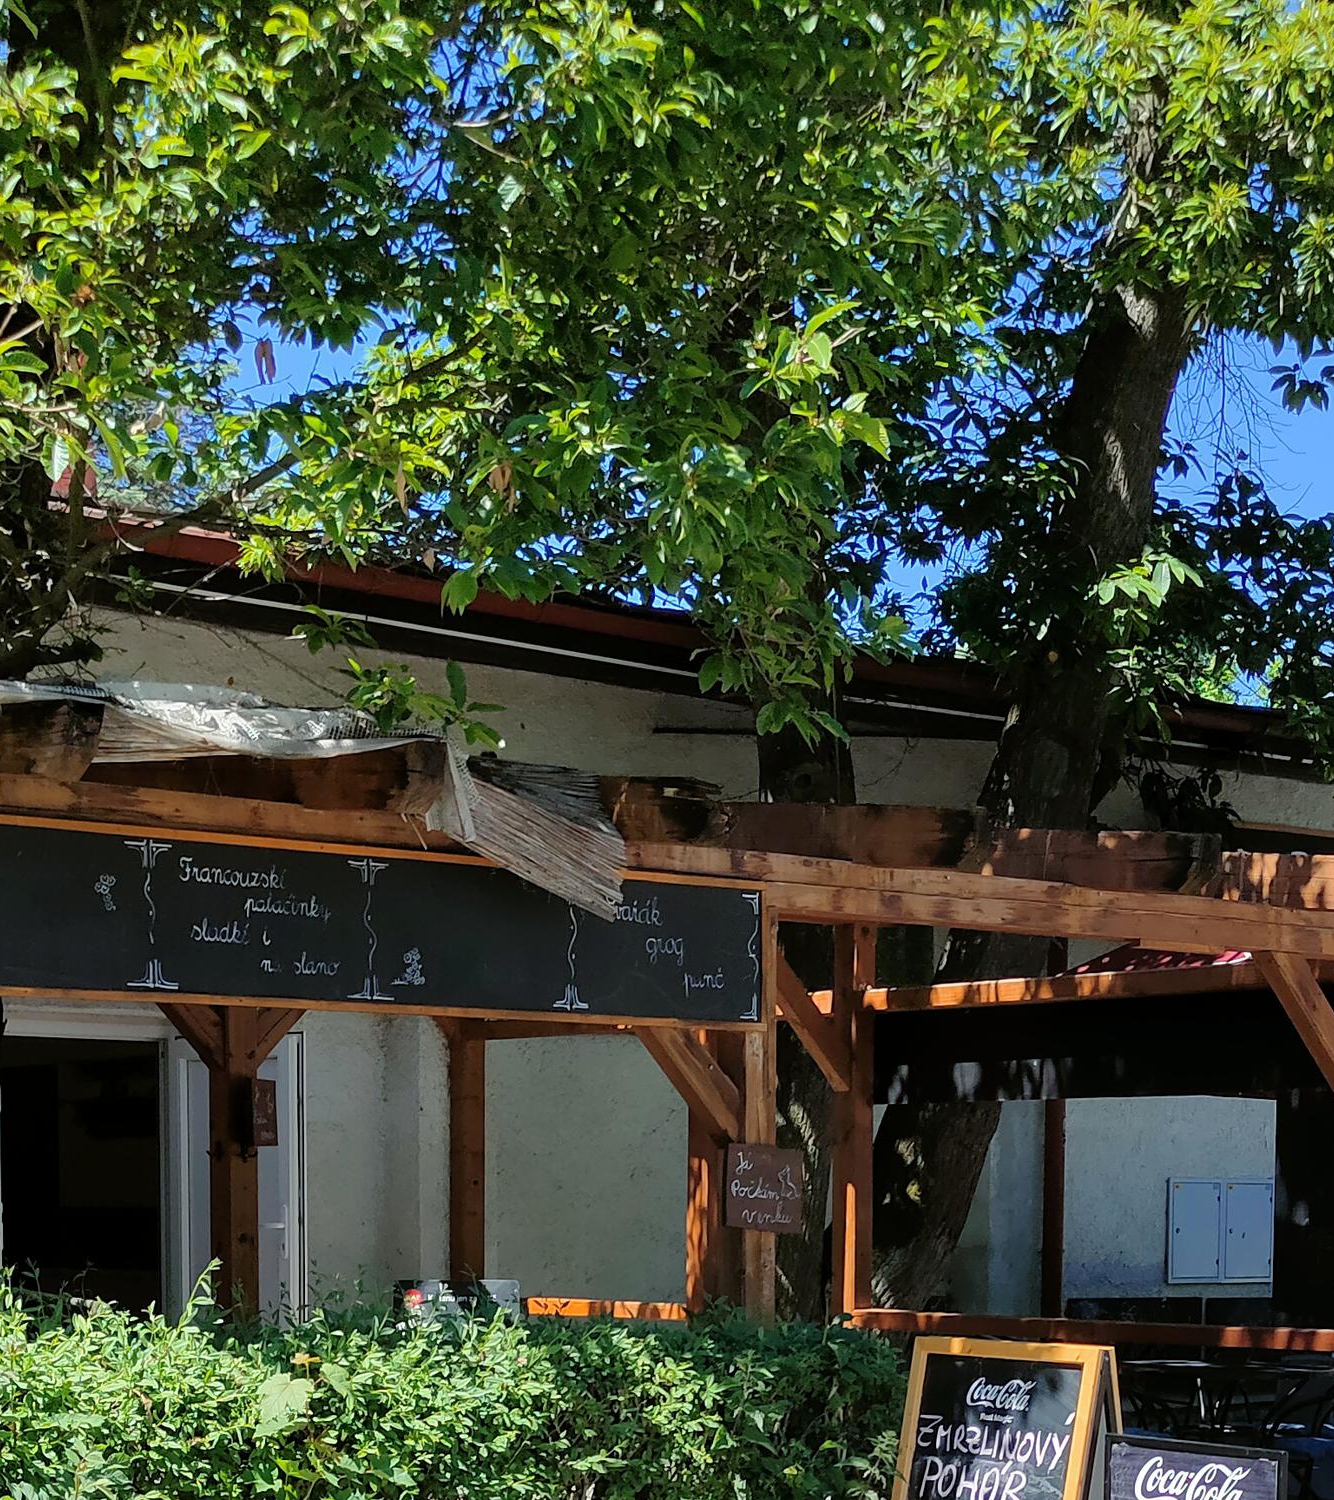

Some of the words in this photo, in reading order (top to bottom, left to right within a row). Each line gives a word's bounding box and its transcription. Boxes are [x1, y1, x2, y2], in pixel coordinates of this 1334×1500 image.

[244, 893, 332, 925] palačinky
[261, 925, 272, 946] i
[645, 937, 684, 966] grog
[293, 951, 341, 976] slano
[683, 967, 725, 999] punč
[966, 1377, 1036, 1411] Coca-Cola
[917, 1411, 1076, 1473] ZMRZLINOVÝ
